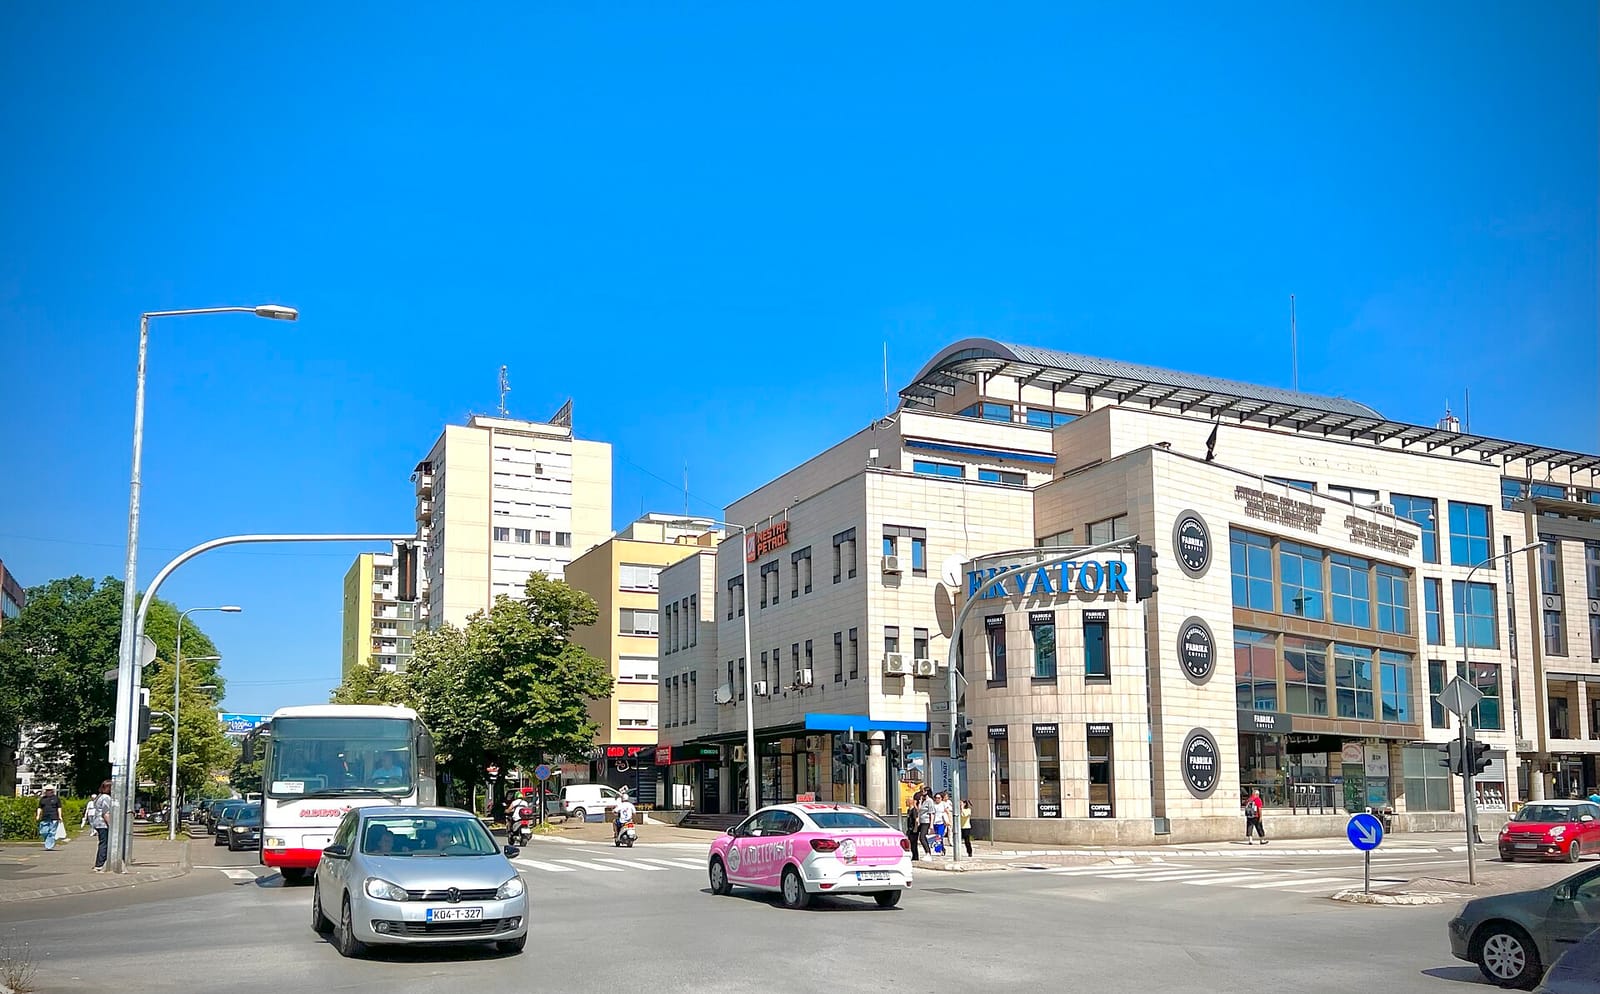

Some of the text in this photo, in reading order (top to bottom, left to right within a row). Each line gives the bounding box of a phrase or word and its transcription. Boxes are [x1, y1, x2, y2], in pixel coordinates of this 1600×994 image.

[757, 520, 788, 543] NESTRO
[757, 532, 788, 556] PETROL
[966, 560, 1131, 600] EKVATOR
[1253, 714, 1275, 724] FABRIKA
[788, 839, 795, 857] 5
[433, 909, 481, 920] K04-T-327
